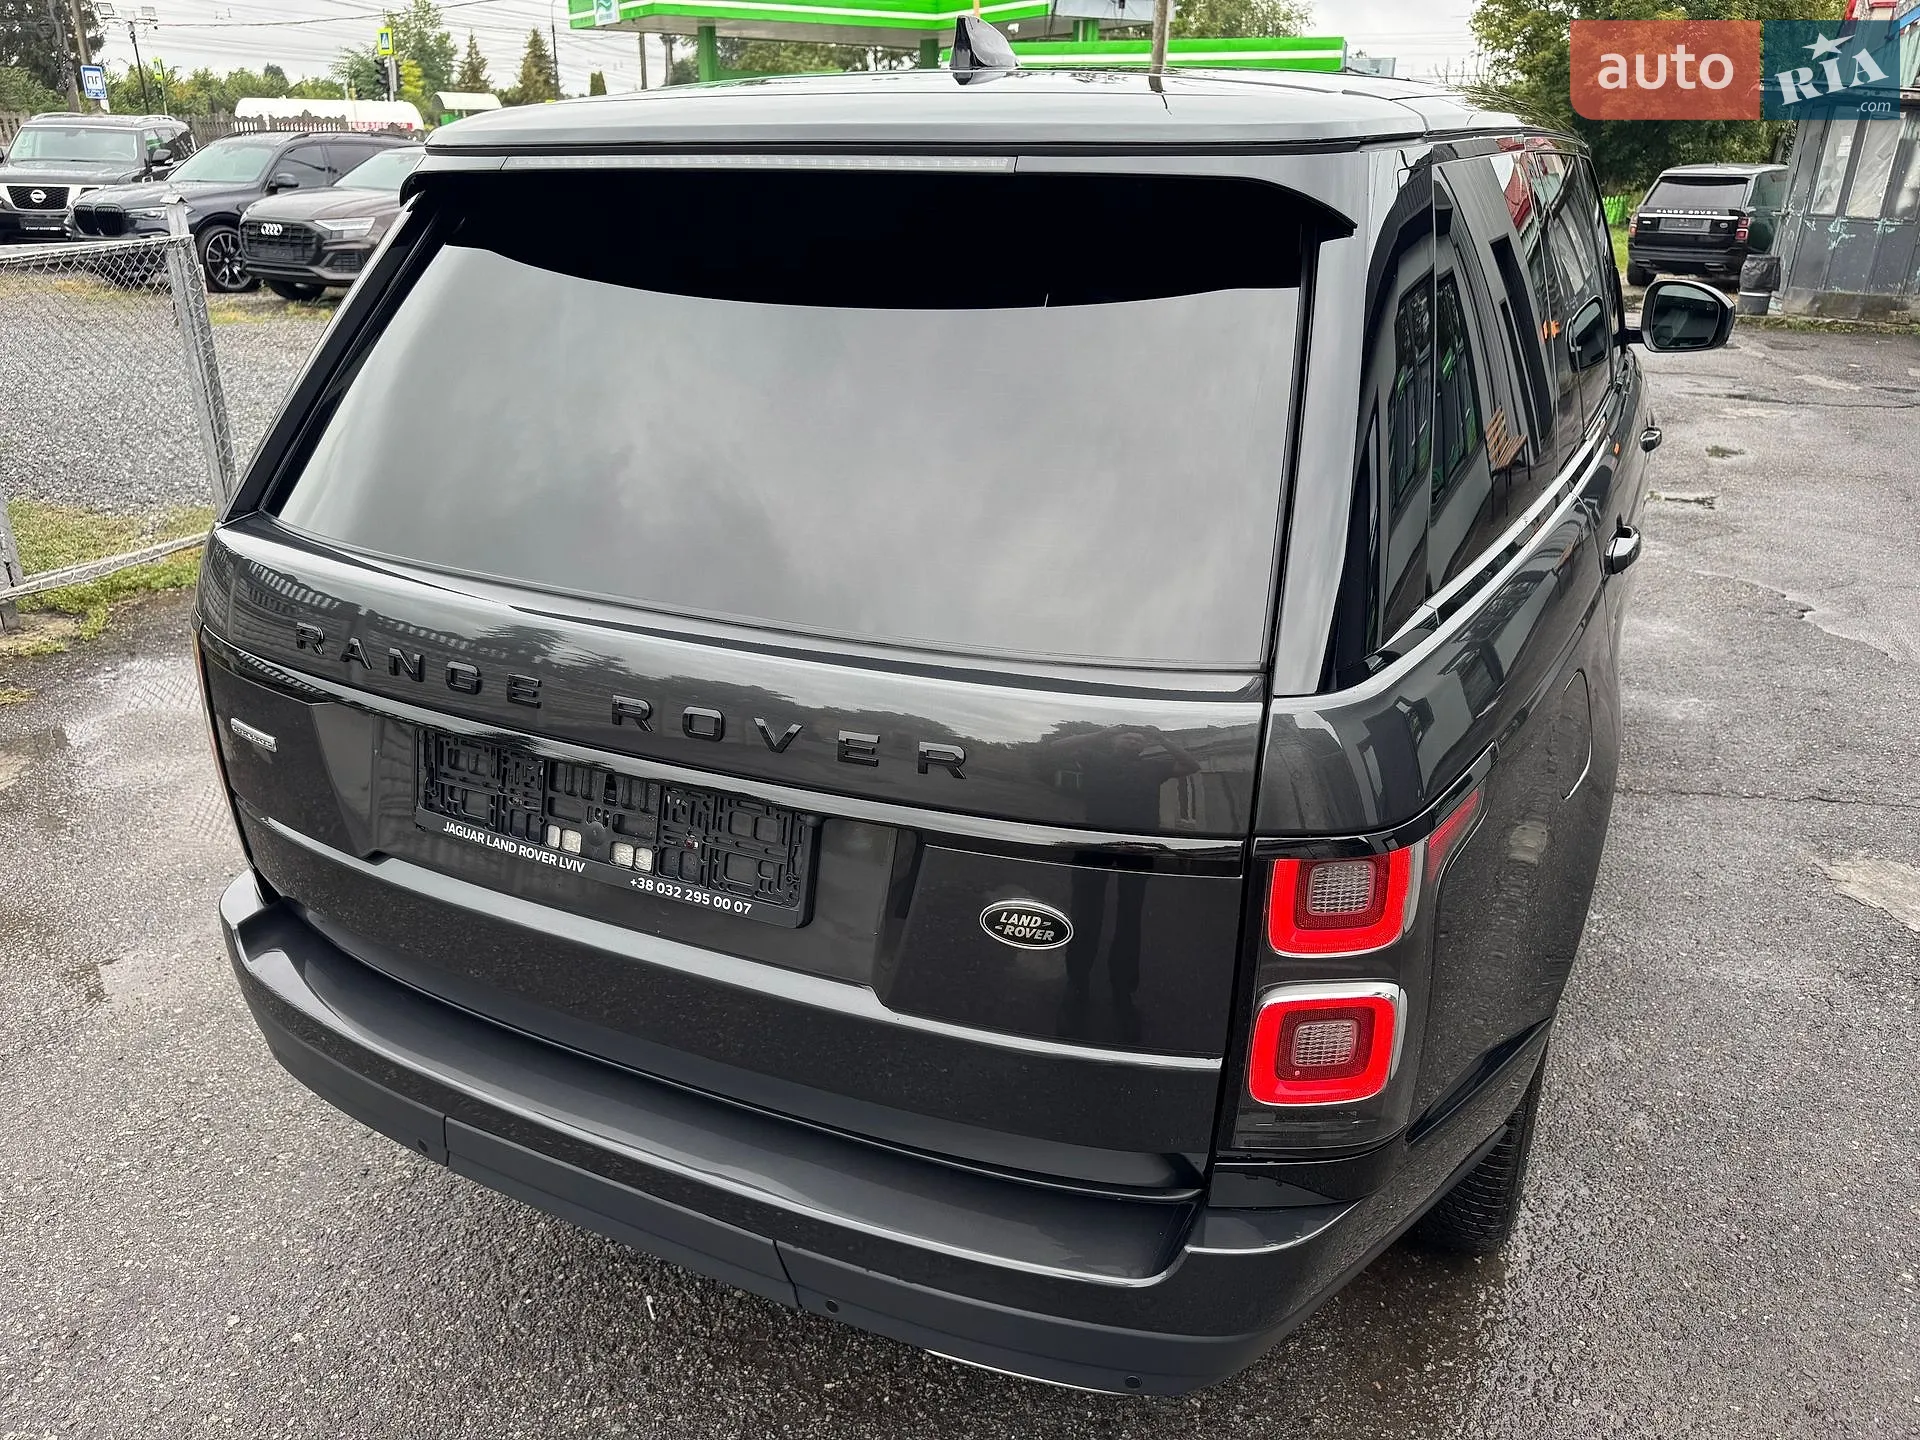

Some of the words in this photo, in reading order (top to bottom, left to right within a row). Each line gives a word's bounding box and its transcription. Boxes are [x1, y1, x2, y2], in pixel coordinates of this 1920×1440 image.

[296, 621, 543, 709] RANGE
[612, 695, 968, 780] ROVER
[442, 821, 485, 844] JAGUAR
[486, 835, 517, 854] LAND
[518, 845, 557, 866] ROVER
[558, 856, 586, 873] LVIV
[630, 877, 654, 891] +38
[656, 882, 681, 898] 032
[684, 889, 710, 905] 295
[713, 896, 731, 910] 00
[733, 901, 752, 915] 07
[999, 911, 1042, 928] LAND
[1003, 924, 1055, 941] ROVER
